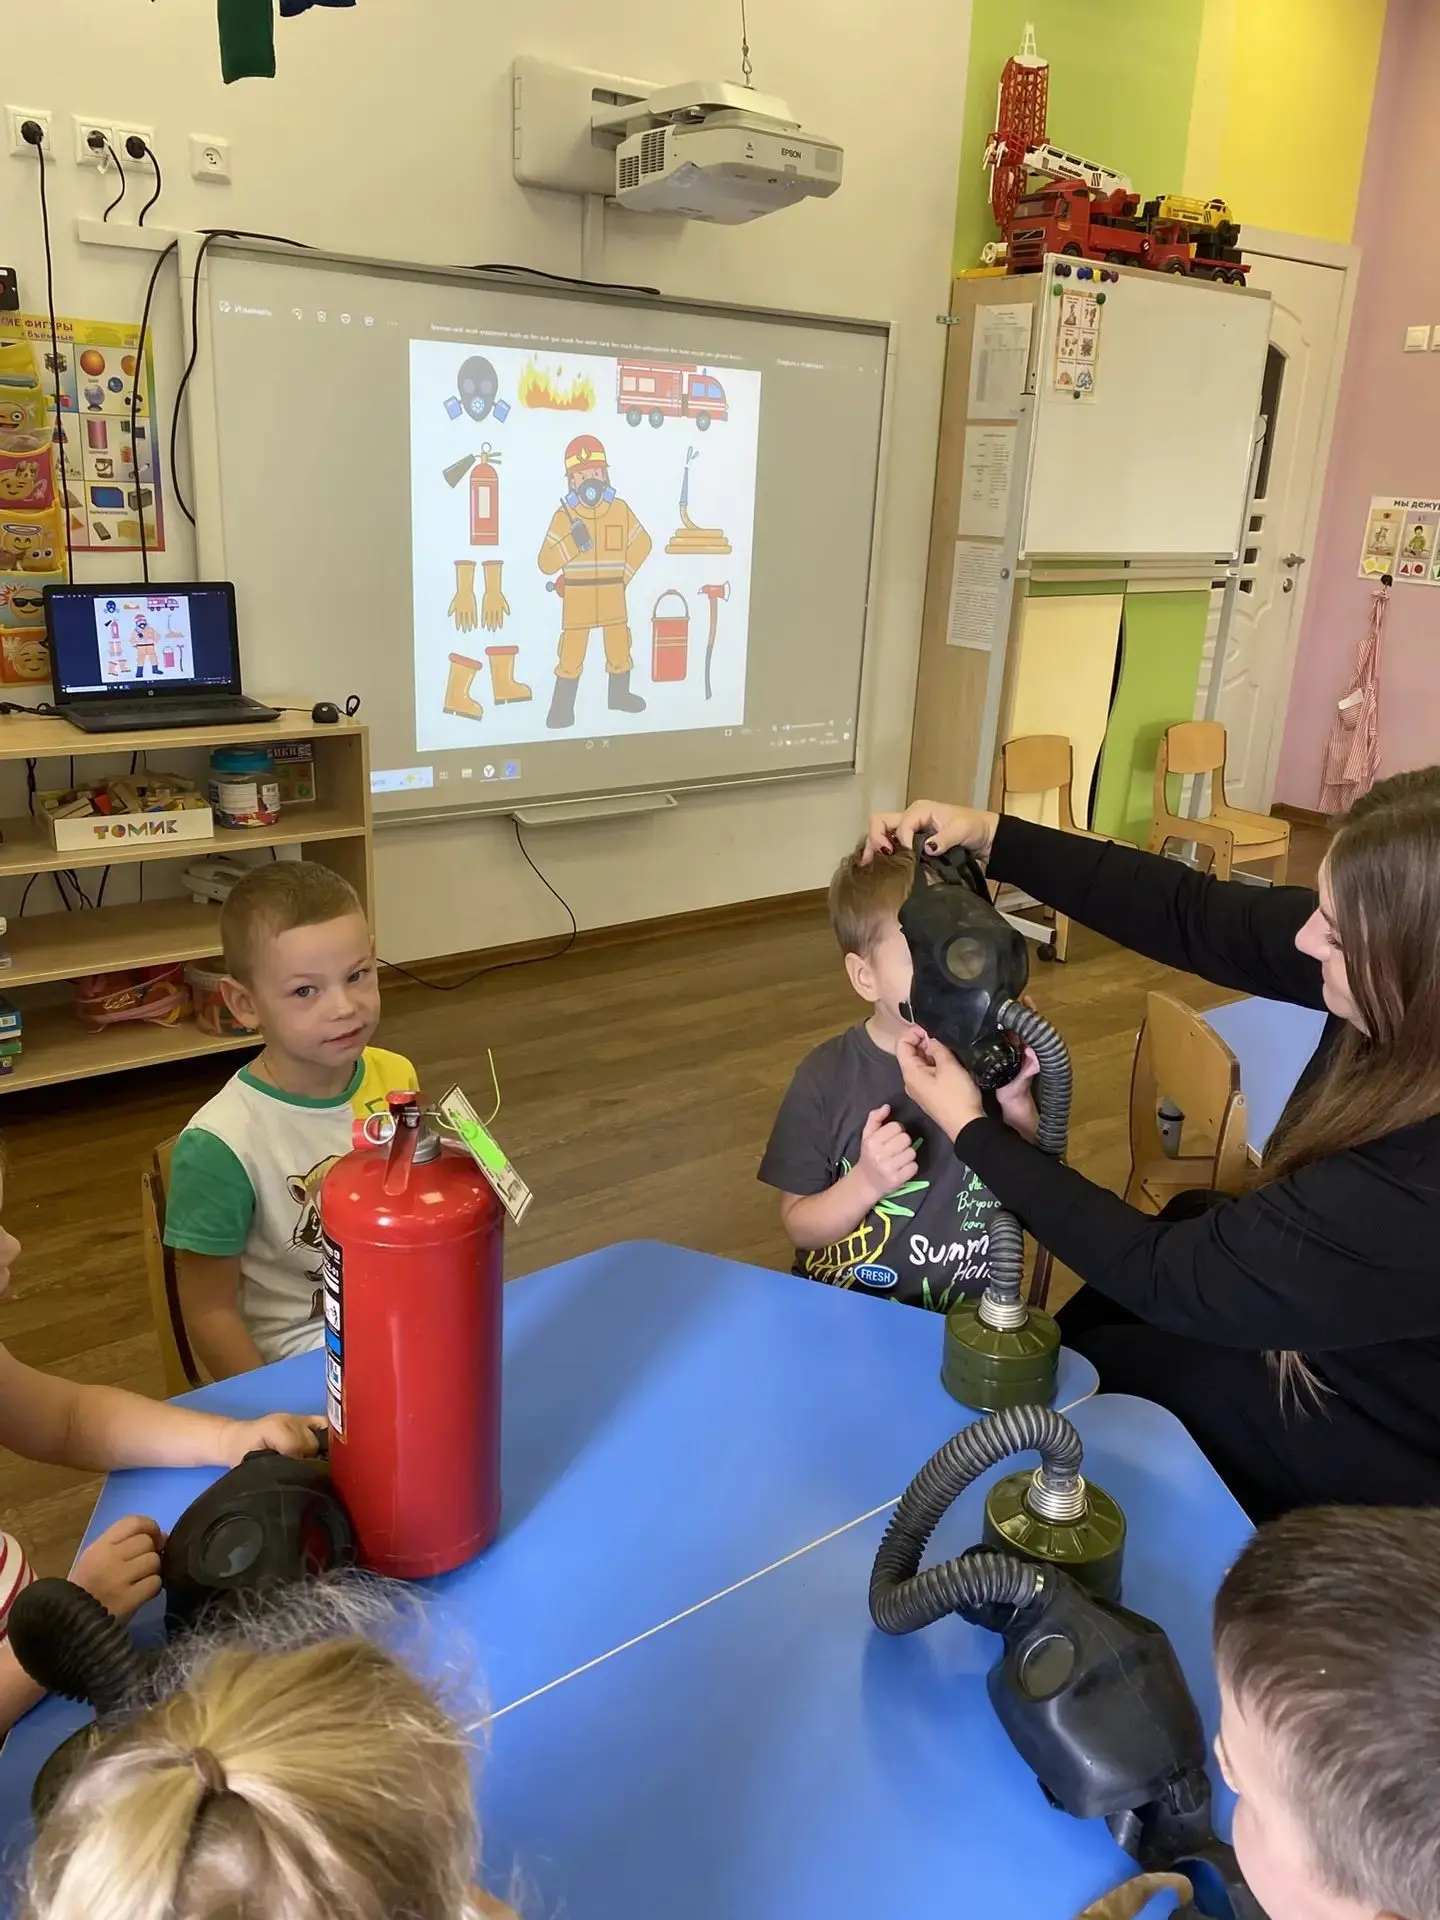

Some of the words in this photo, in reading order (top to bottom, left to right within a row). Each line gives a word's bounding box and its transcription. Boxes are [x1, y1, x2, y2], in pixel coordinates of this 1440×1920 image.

[781, 147, 802, 159] EPSON
[24, 319, 73, 332] ФИГРЫ
[93, 819, 179, 840] ТОМИК
[909, 1234, 990, 1267] Summ
[861, 1268, 891, 1283] FRESH
[953, 1259, 993, 1281] Holi
